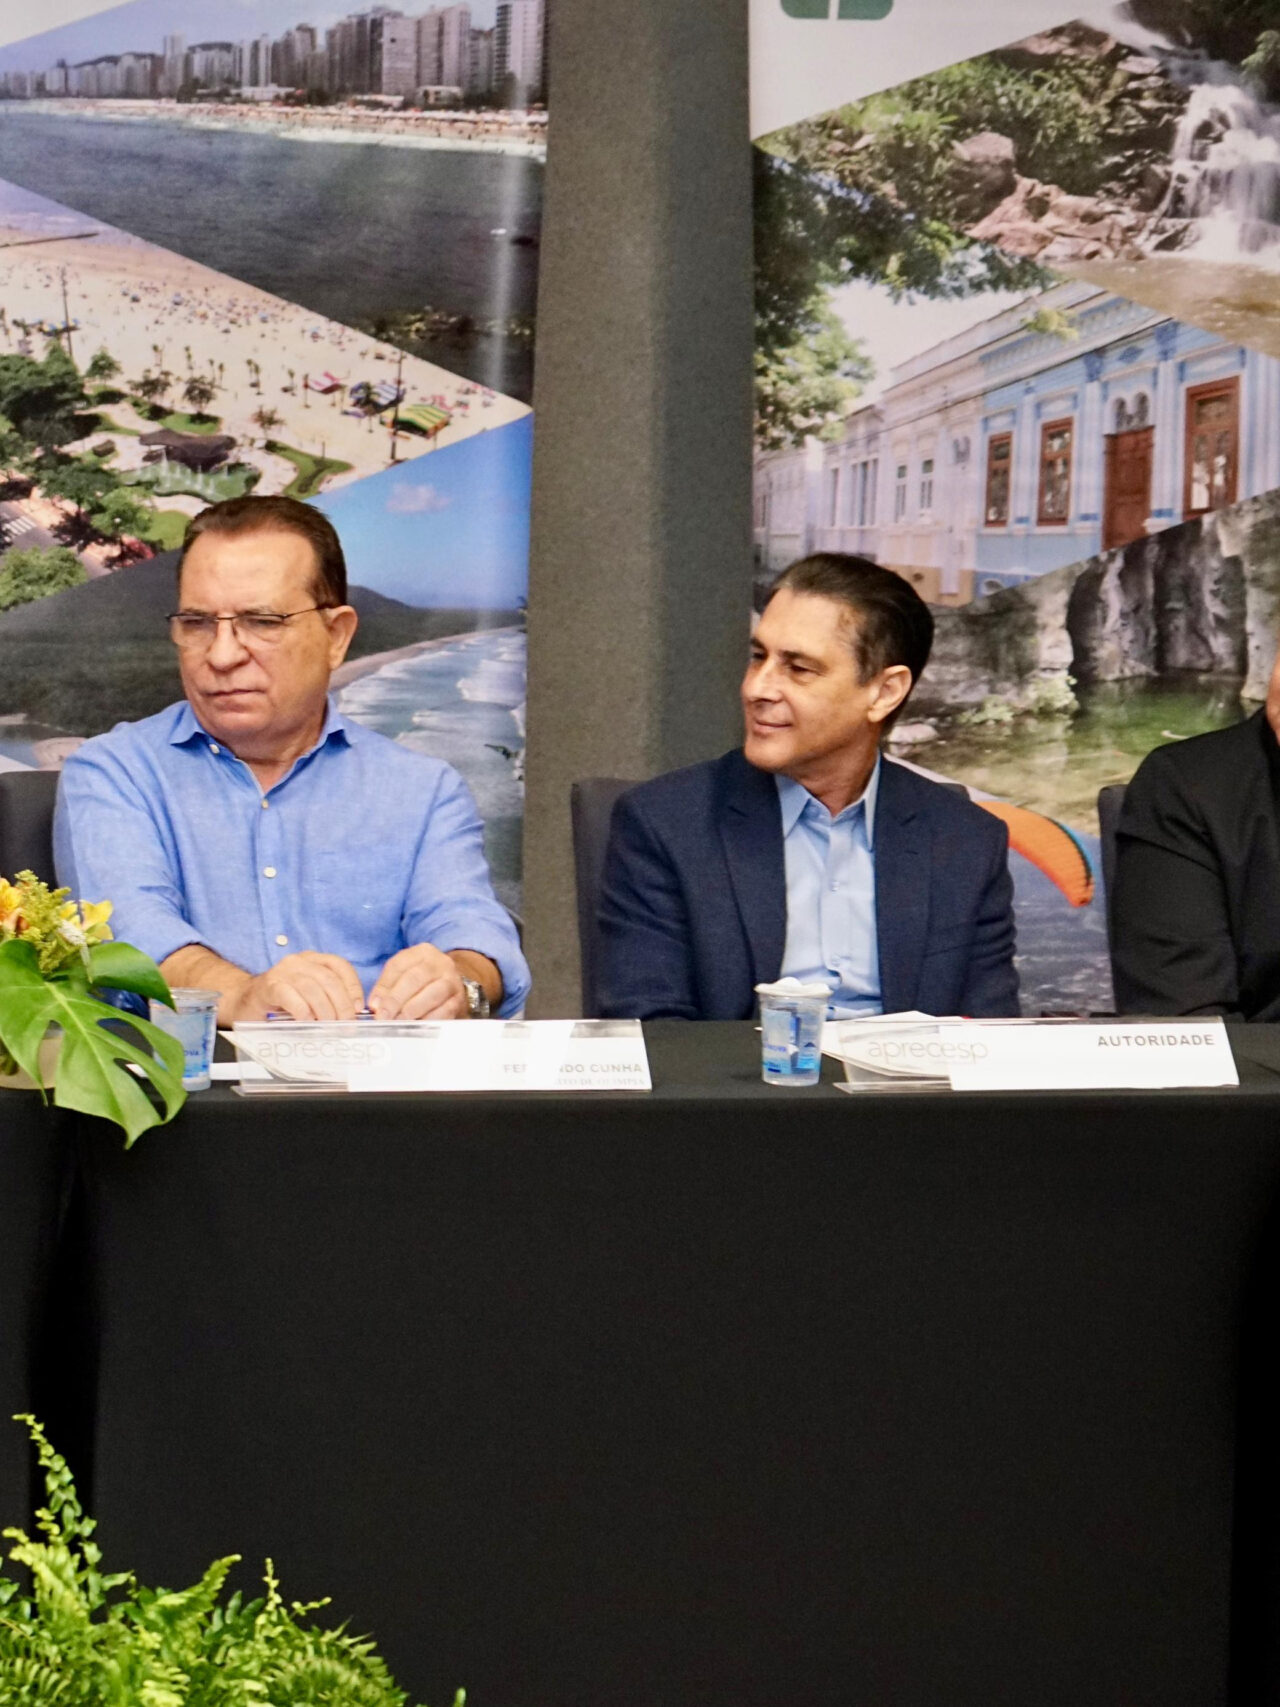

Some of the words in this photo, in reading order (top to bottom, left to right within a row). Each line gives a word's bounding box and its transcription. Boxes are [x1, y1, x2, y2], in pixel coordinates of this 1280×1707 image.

[1097, 1034, 1215, 1047] AUTORIDADE
[257, 1040, 386, 1066] aprecesp
[869, 1041, 989, 1064] aprecesp
[589, 1063, 643, 1073] CUNHA
